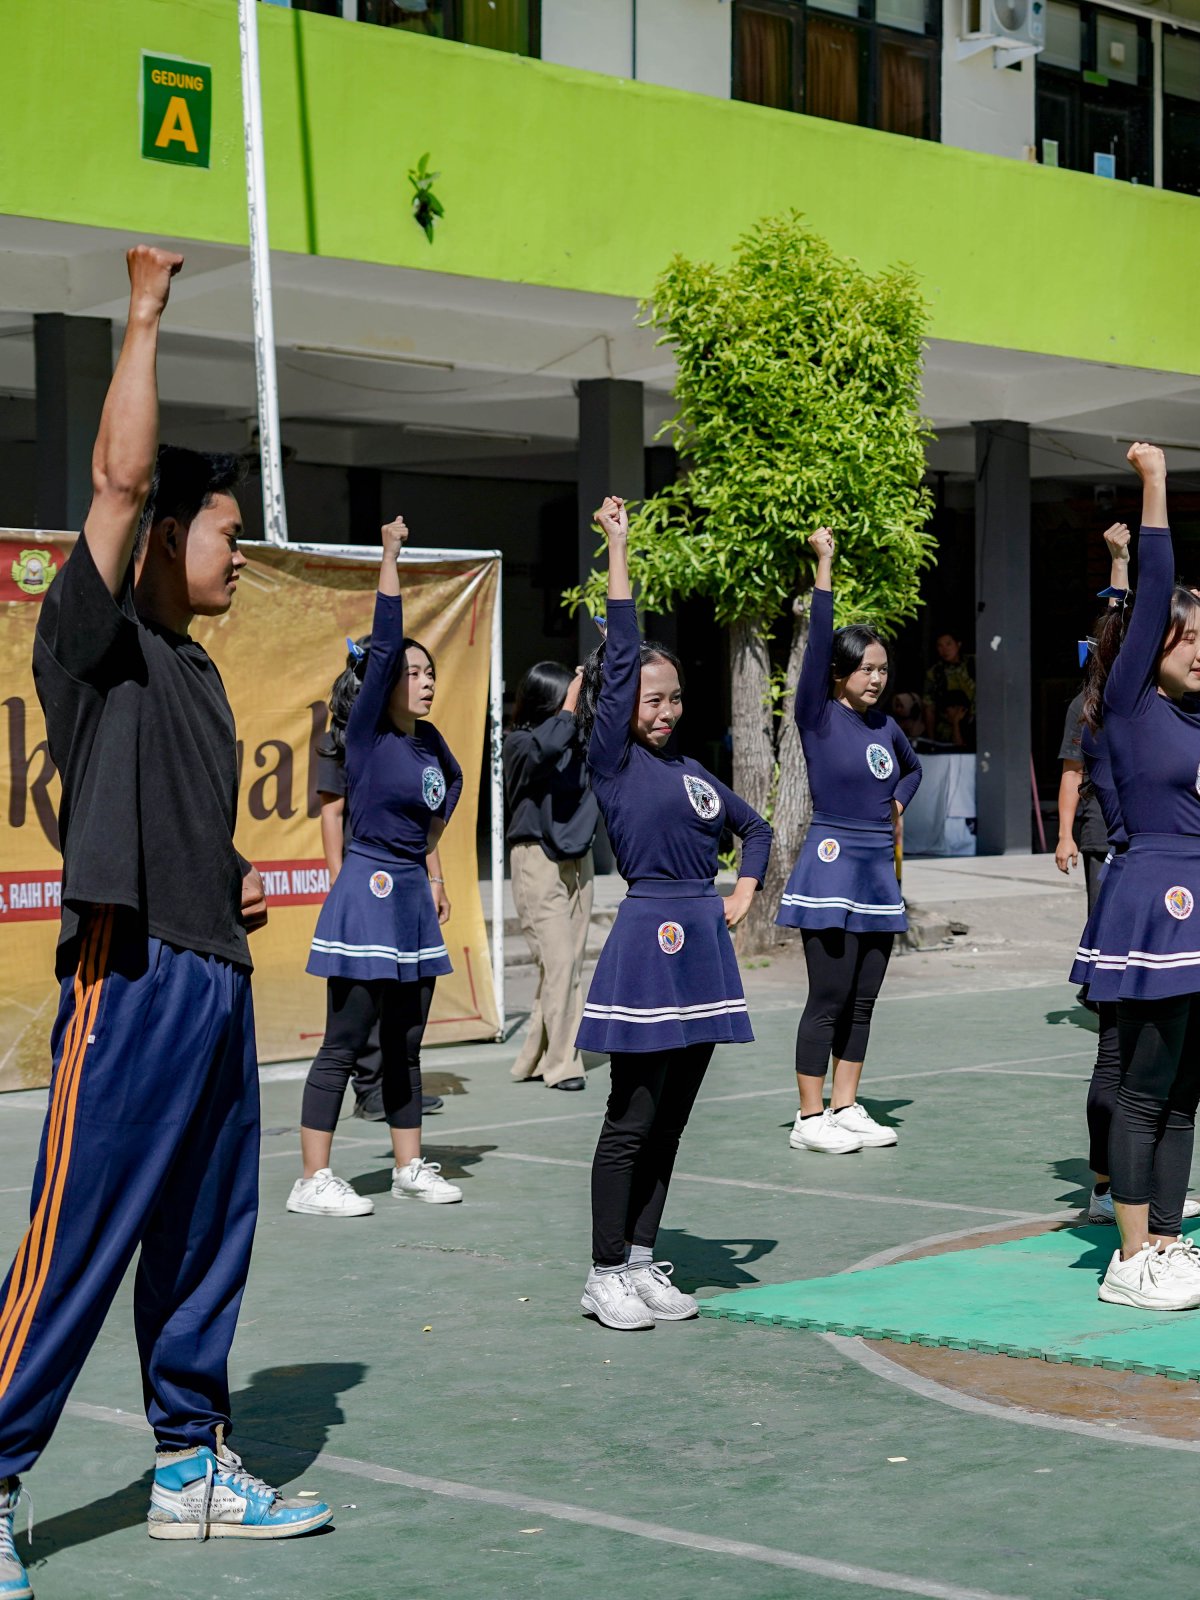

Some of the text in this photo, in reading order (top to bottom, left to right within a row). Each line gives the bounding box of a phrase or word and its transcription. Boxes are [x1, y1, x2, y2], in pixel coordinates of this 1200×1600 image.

[151, 69, 204, 91] GEDUNG
[154, 95, 199, 153] A
[9, 882, 42, 909] RAIH
